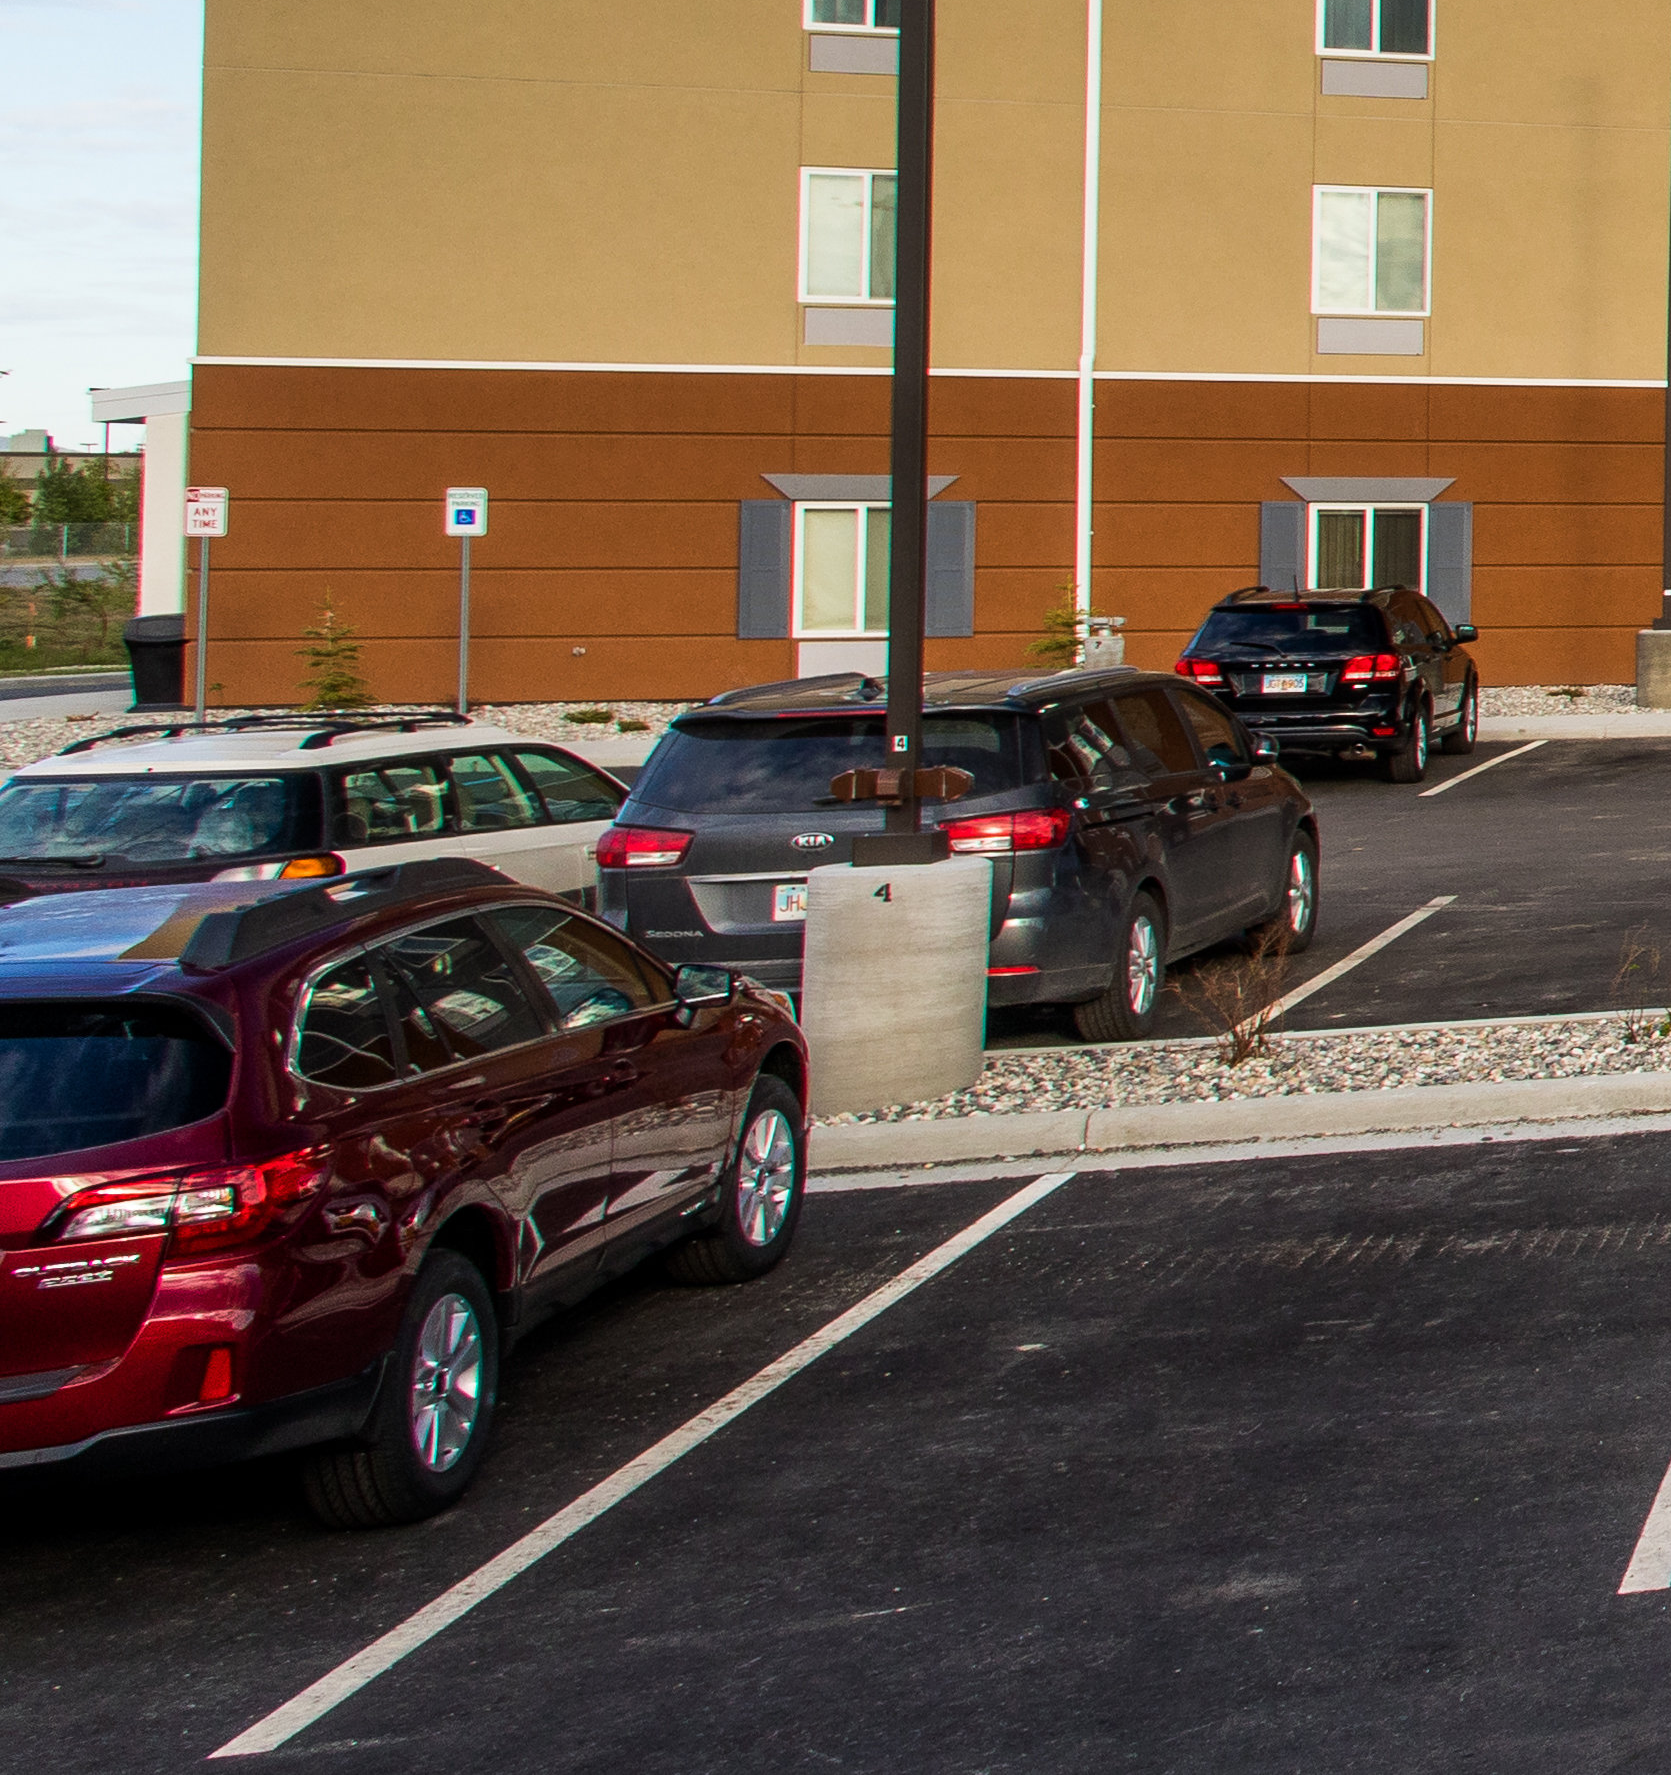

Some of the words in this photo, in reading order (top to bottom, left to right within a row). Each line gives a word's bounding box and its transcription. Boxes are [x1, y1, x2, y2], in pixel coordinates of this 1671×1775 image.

[194, 508, 217, 516] ANY
[193, 520, 217, 528] TIME
[896, 737, 905, 749] 4
[797, 835, 827, 847] KIA
[874, 883, 892, 902] 4
